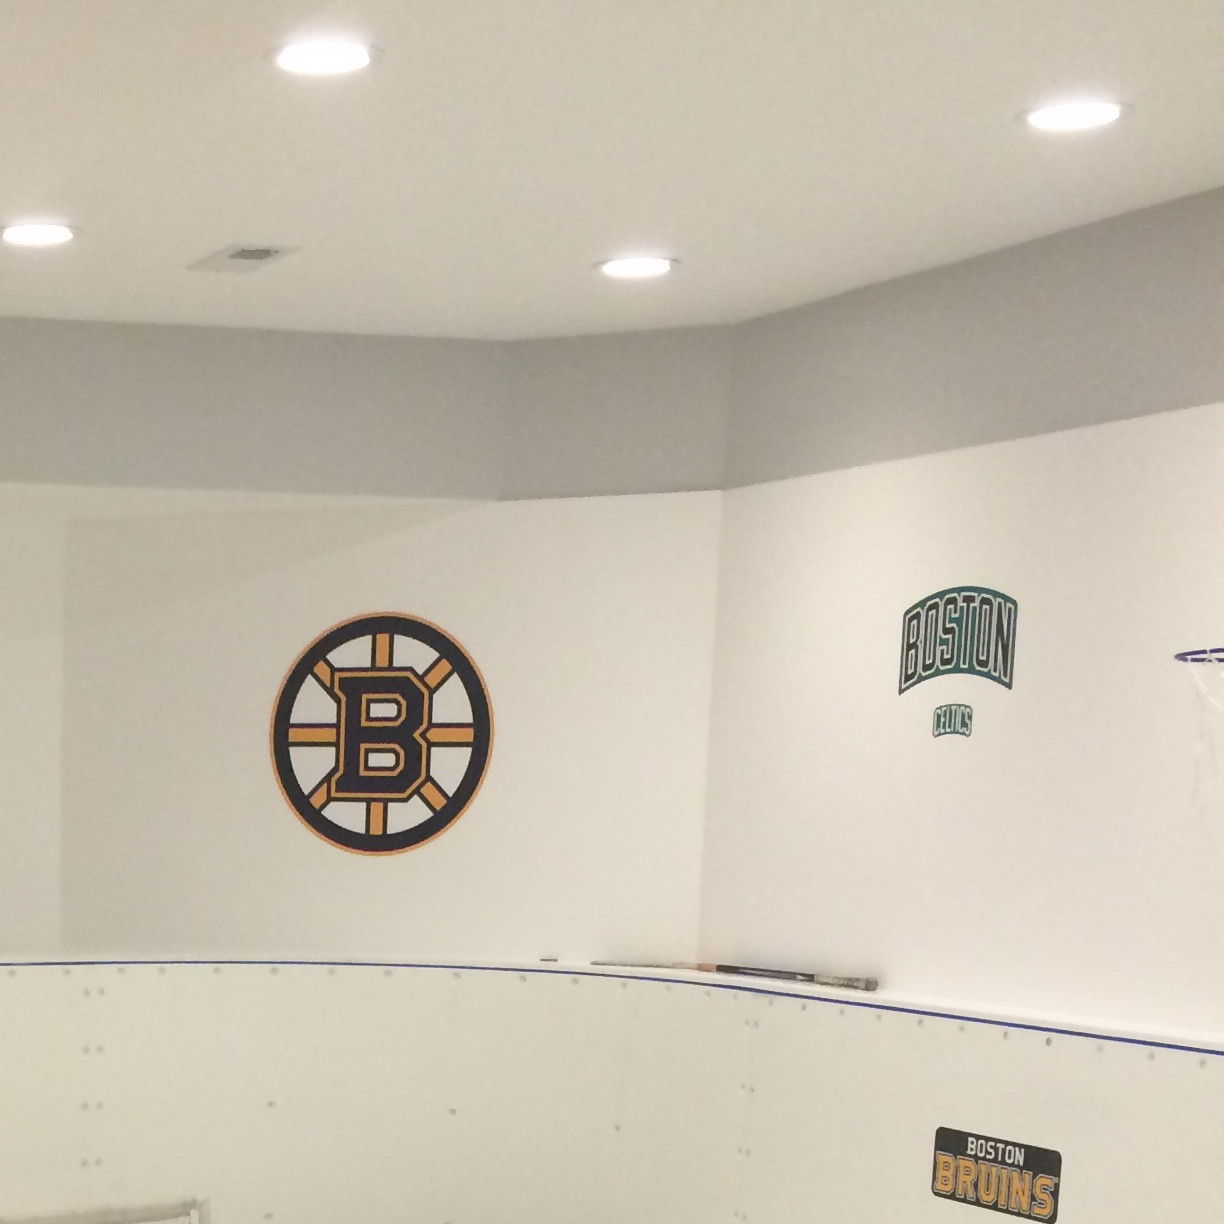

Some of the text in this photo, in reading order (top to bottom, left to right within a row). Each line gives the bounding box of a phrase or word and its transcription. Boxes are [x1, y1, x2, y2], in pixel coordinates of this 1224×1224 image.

[901, 591, 1014, 690] BOSTON
[330, 668, 432, 801] B
[933, 704, 972, 736] CELTICS
[934, 1151, 1058, 1219] BRUINS
[967, 1136, 1024, 1166] BOSTON
